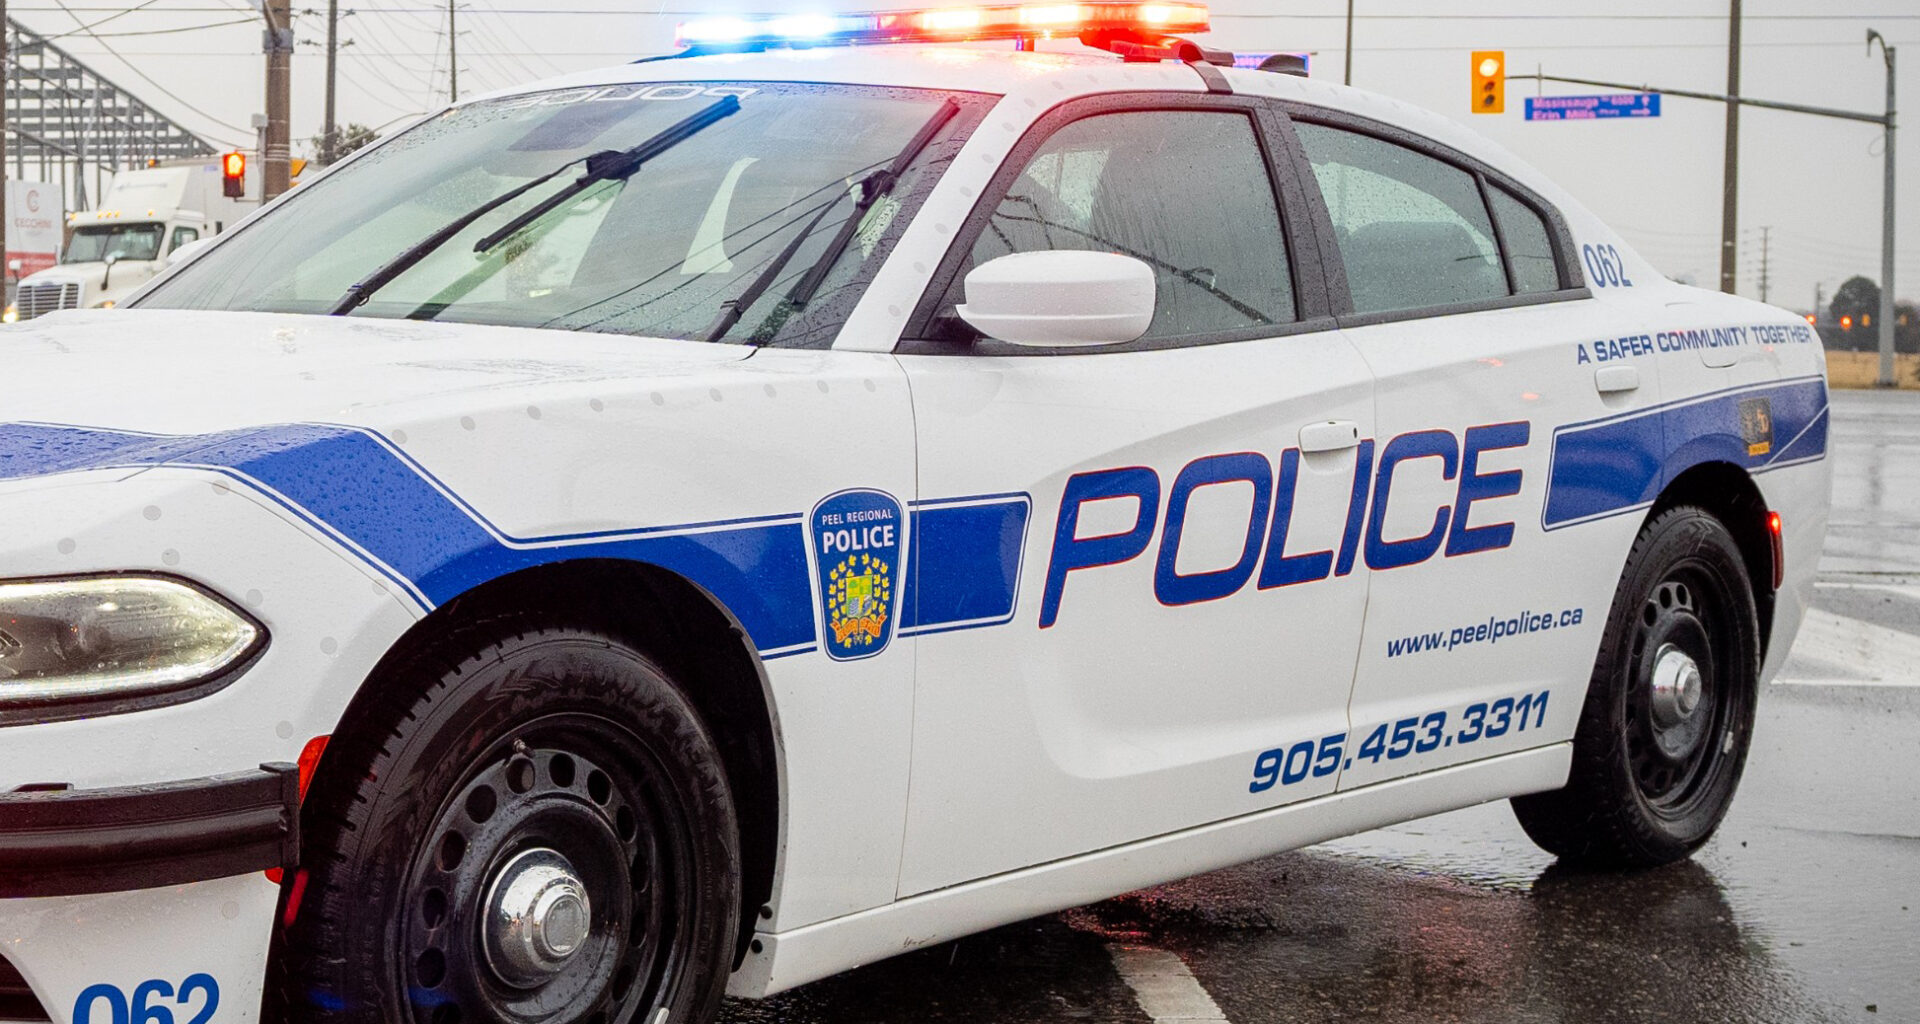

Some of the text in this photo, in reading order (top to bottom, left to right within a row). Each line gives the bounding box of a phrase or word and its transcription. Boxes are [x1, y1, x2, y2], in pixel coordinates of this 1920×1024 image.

[1532, 98, 1599, 110] Mississauga
[1532, 109, 1561, 120] Erin
[1565, 109, 1597, 119] Mills
[1583, 243, 1633, 288] 062
[1577, 325, 1811, 365] A SAFER COMMUNITY TOGETHER
[822, 508, 893, 526] PEEL REGIONAL
[1038, 420, 1531, 630] POLICE
[822, 524, 895, 554] POLICE
[1387, 607, 1583, 658] www.peelpolice.ca
[1249, 690, 1550, 794] 905.453.3311
[72, 972, 220, 1024] 062
